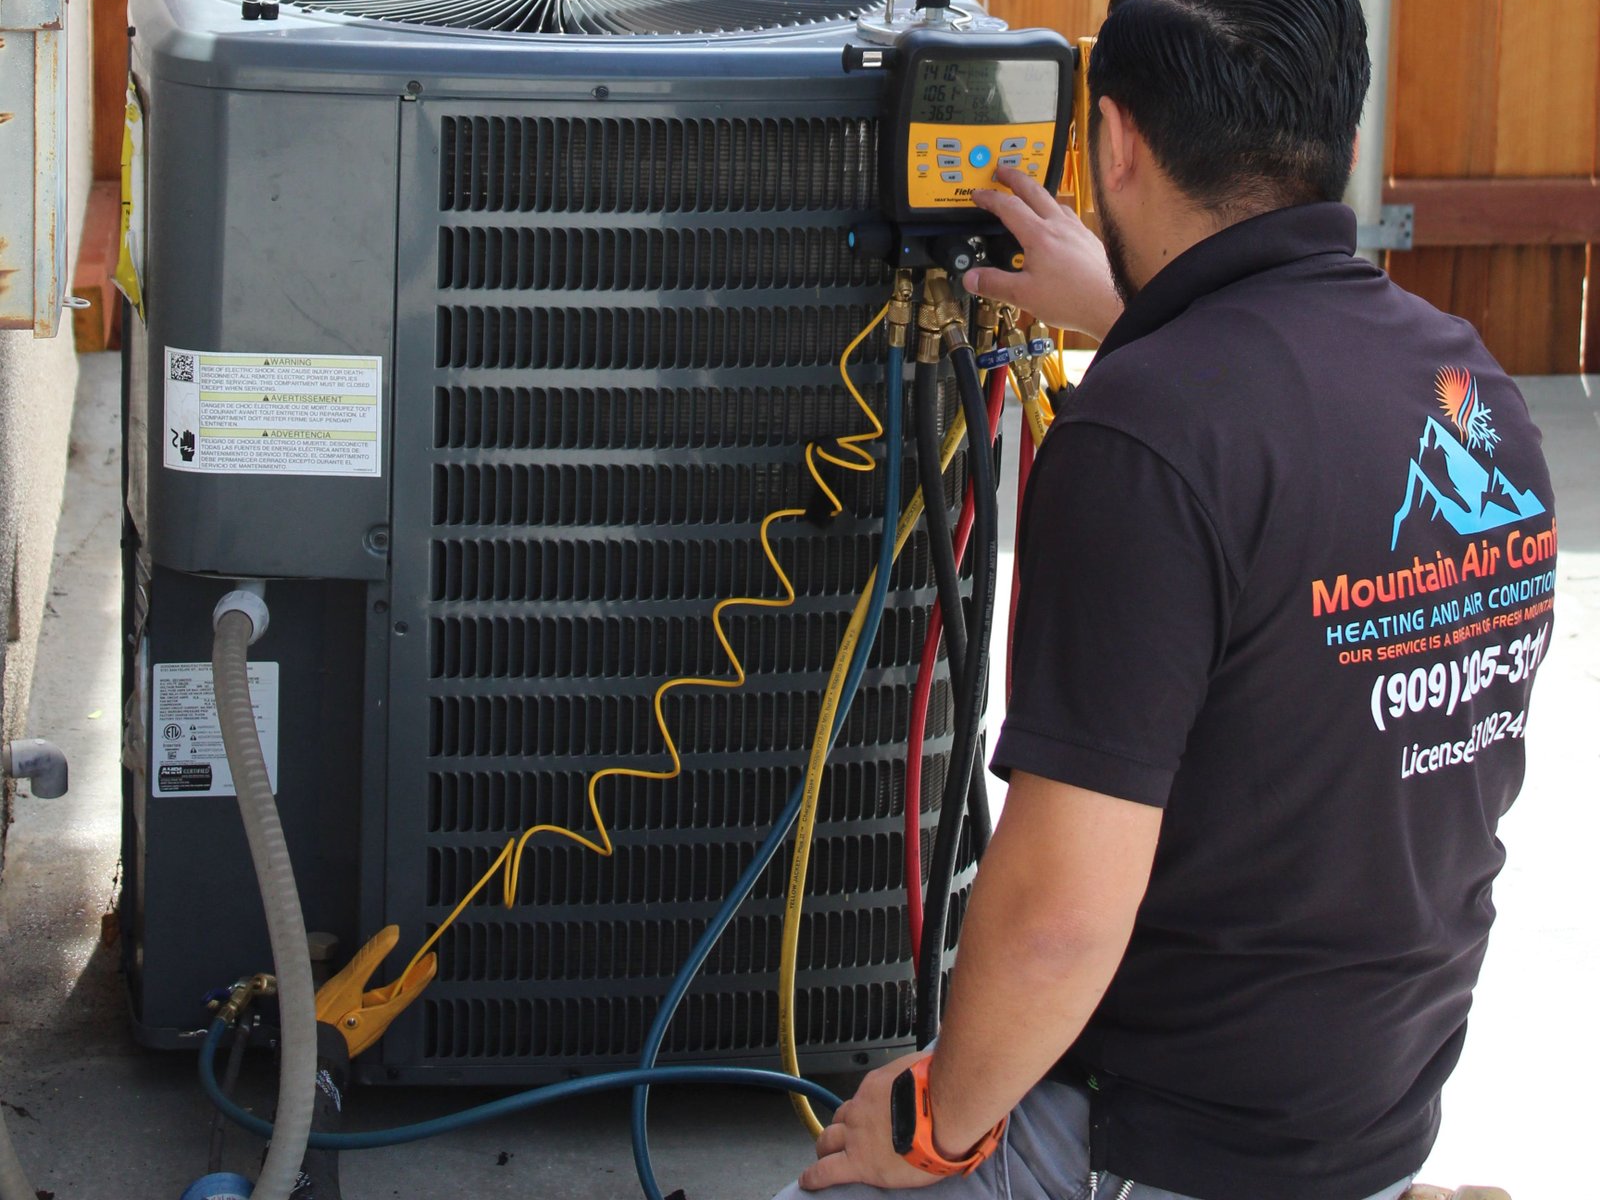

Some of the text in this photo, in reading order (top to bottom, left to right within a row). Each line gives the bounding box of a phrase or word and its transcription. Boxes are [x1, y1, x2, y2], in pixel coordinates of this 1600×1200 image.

[271, 395, 342, 403] AVERTISSEMENT
[271, 430, 331, 439] ADVERTENCIA
[1312, 551, 1458, 616] Mountain
[1461, 540, 1500, 582] Air
[1327, 609, 1424, 646] HEATING
[1430, 600, 1459, 627] AND
[1463, 592, 1483, 618] AIR
[1339, 648, 1372, 664] OUR
[1377, 637, 1426, 661] SERVICE
[1429, 634, 1441, 649] IS
[1444, 634, 1451, 647] A
[1493, 612, 1522, 630] FRESH
[1371, 661, 1460, 731] (909)
[1402, 738, 1474, 778] License
[788, 883, 798, 909] YELLOW
[802, 796, 812, 822] Charging
